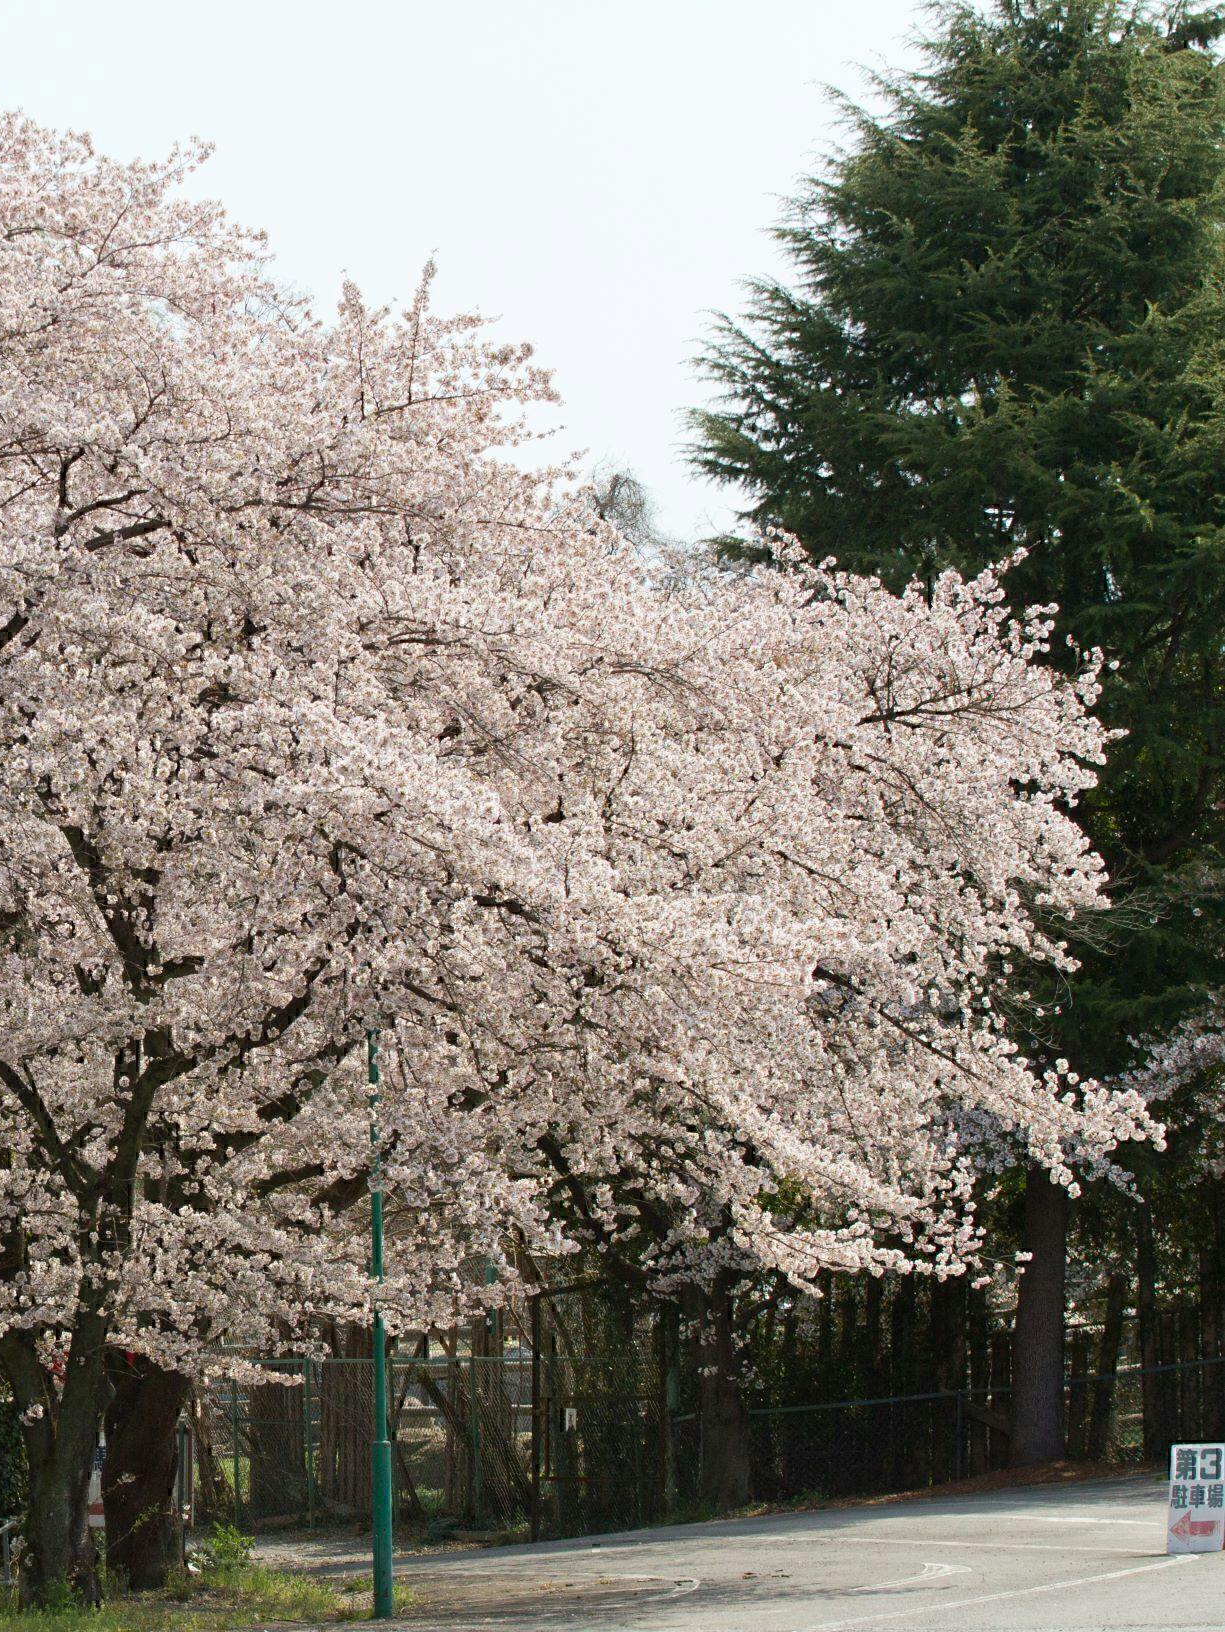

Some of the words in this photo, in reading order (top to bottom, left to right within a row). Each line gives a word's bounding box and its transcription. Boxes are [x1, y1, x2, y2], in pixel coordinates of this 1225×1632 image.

[1175, 1448, 1223, 1480] 第3
[1171, 1484, 1224, 1509] 駐車場
